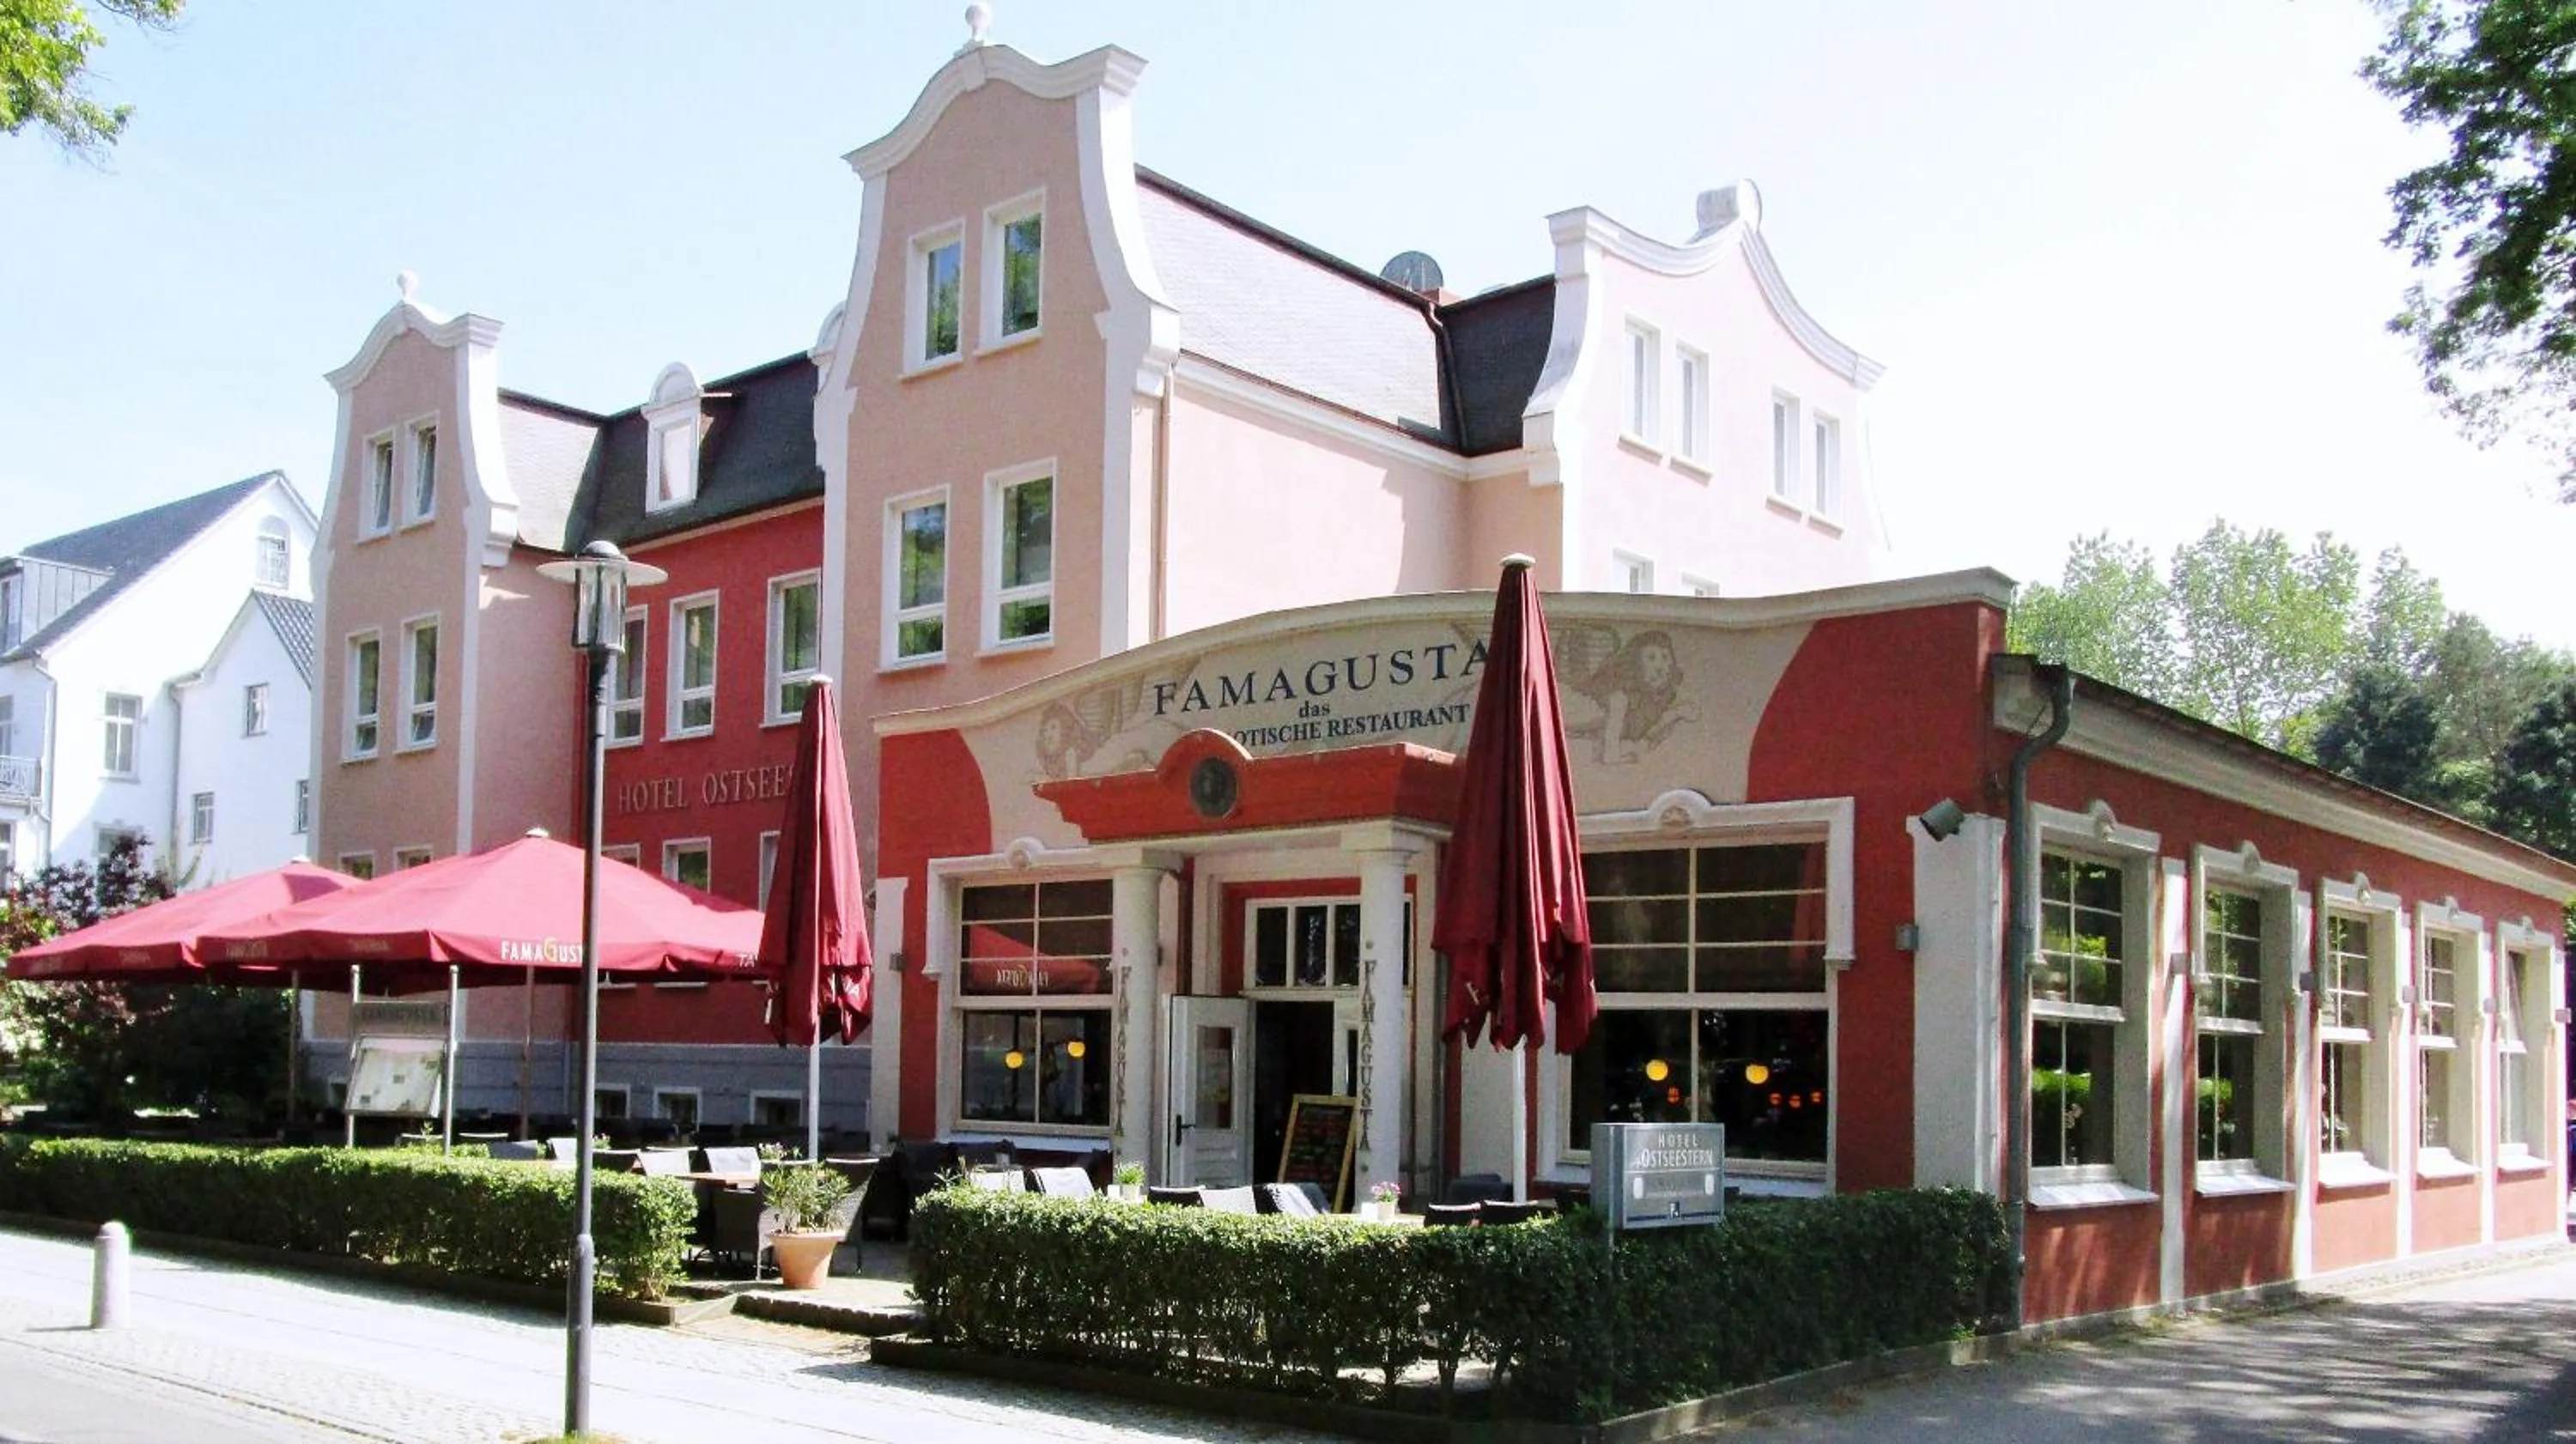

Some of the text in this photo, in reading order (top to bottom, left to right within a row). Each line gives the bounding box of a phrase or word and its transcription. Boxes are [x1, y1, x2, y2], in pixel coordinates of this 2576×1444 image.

[1153, 638, 1489, 716] FAMAGUSTA
[1297, 700, 1331, 719] das
[1230, 702, 1471, 748] OTISCHE RESTAURANT
[618, 777, 688, 813] HOTEL
[501, 937, 583, 962] FAMAGUST
[1658, 1132, 1699, 1148] HOTEL
